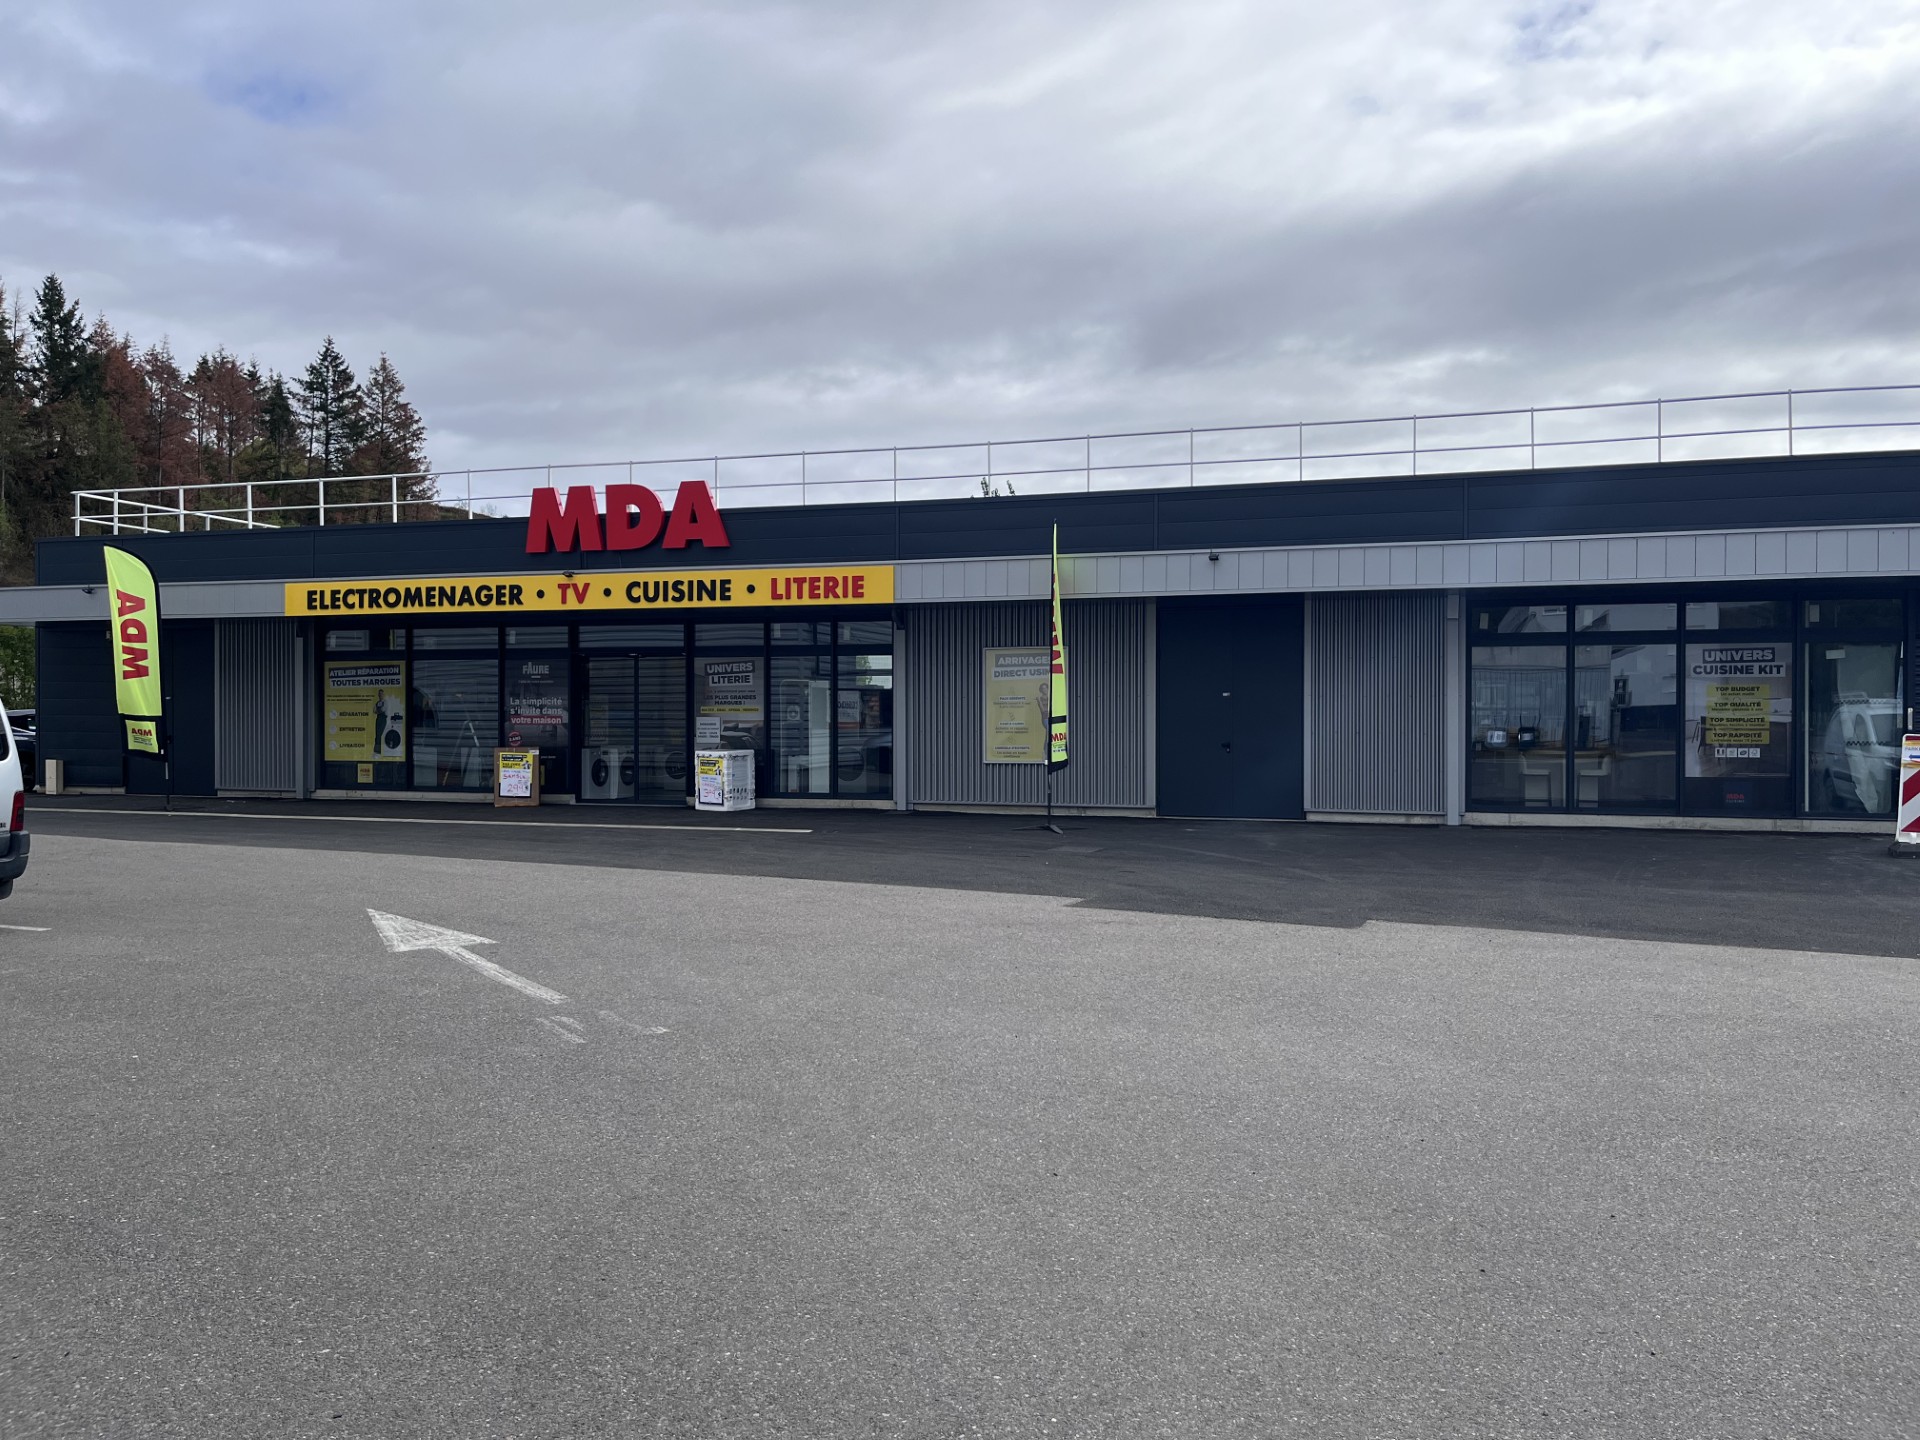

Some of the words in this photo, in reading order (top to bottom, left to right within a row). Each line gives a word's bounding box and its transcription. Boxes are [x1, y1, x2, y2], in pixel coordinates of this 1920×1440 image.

[525, 480, 730, 553] MDA
[306, 584, 524, 611] ELECTROMENAGER
[557, 582, 591, 605] TV
[625, 579, 732, 603] CUISINE
[770, 575, 865, 601] LITERIE
[997, 655, 1050, 665] ARRIVAGE
[1704, 649, 1773, 662] UNIVERS
[329, 669, 357, 678] ATELIER
[706, 662, 753, 674] UNIVERS
[993, 669, 1028, 678] DIRECT
[1029, 667, 1050, 677] USIN
[1692, 665, 1754, 675] CUISINE
[1758, 664, 1784, 675] KIT
[331, 679, 362, 687] TOUTES
[362, 678, 401, 687] MARQUES
[711, 675, 751, 685] LITERIE
[510, 697, 520, 705] La
[522, 696, 563, 707] simplicité
[510, 706, 541, 715] s'invite
[542, 706, 563, 715] dans
[532, 716, 562, 724] maison
